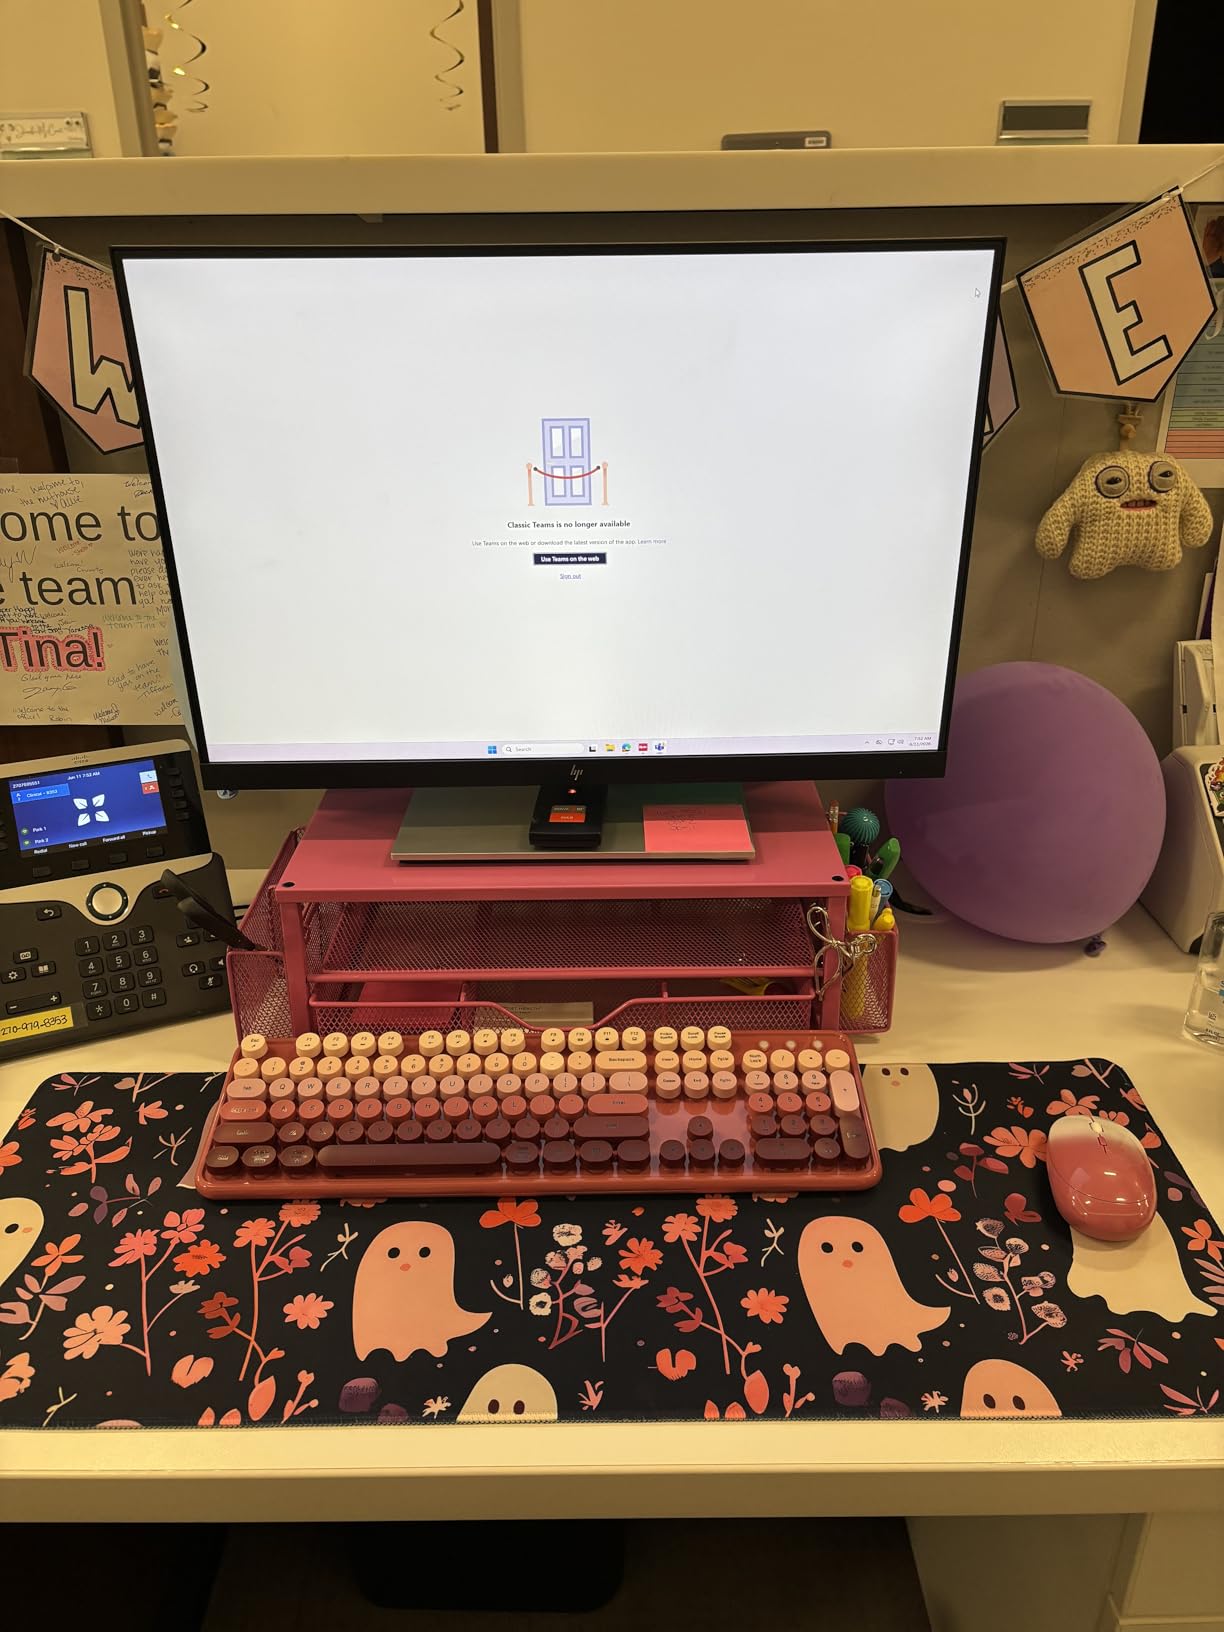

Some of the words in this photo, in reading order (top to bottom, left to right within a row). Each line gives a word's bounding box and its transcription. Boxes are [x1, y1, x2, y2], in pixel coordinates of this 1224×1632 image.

[1078, 239, 1173, 386] E
[117, 505, 161, 541] to
[574, 520, 598, 529] longer
[19, 571, 137, 605] team
[0, 631, 102, 668] Tina!
[138, 930, 145, 938] 3
[112, 935, 118, 943] 2
[85, 941, 90, 949] 1
[143, 950, 149, 958] 6
[115, 956, 122, 964] 5
[88, 962, 94, 970] 4
[147, 971, 153, 980] 9
[120, 977, 126, 986] 8
[92, 982, 98, 991] 7
